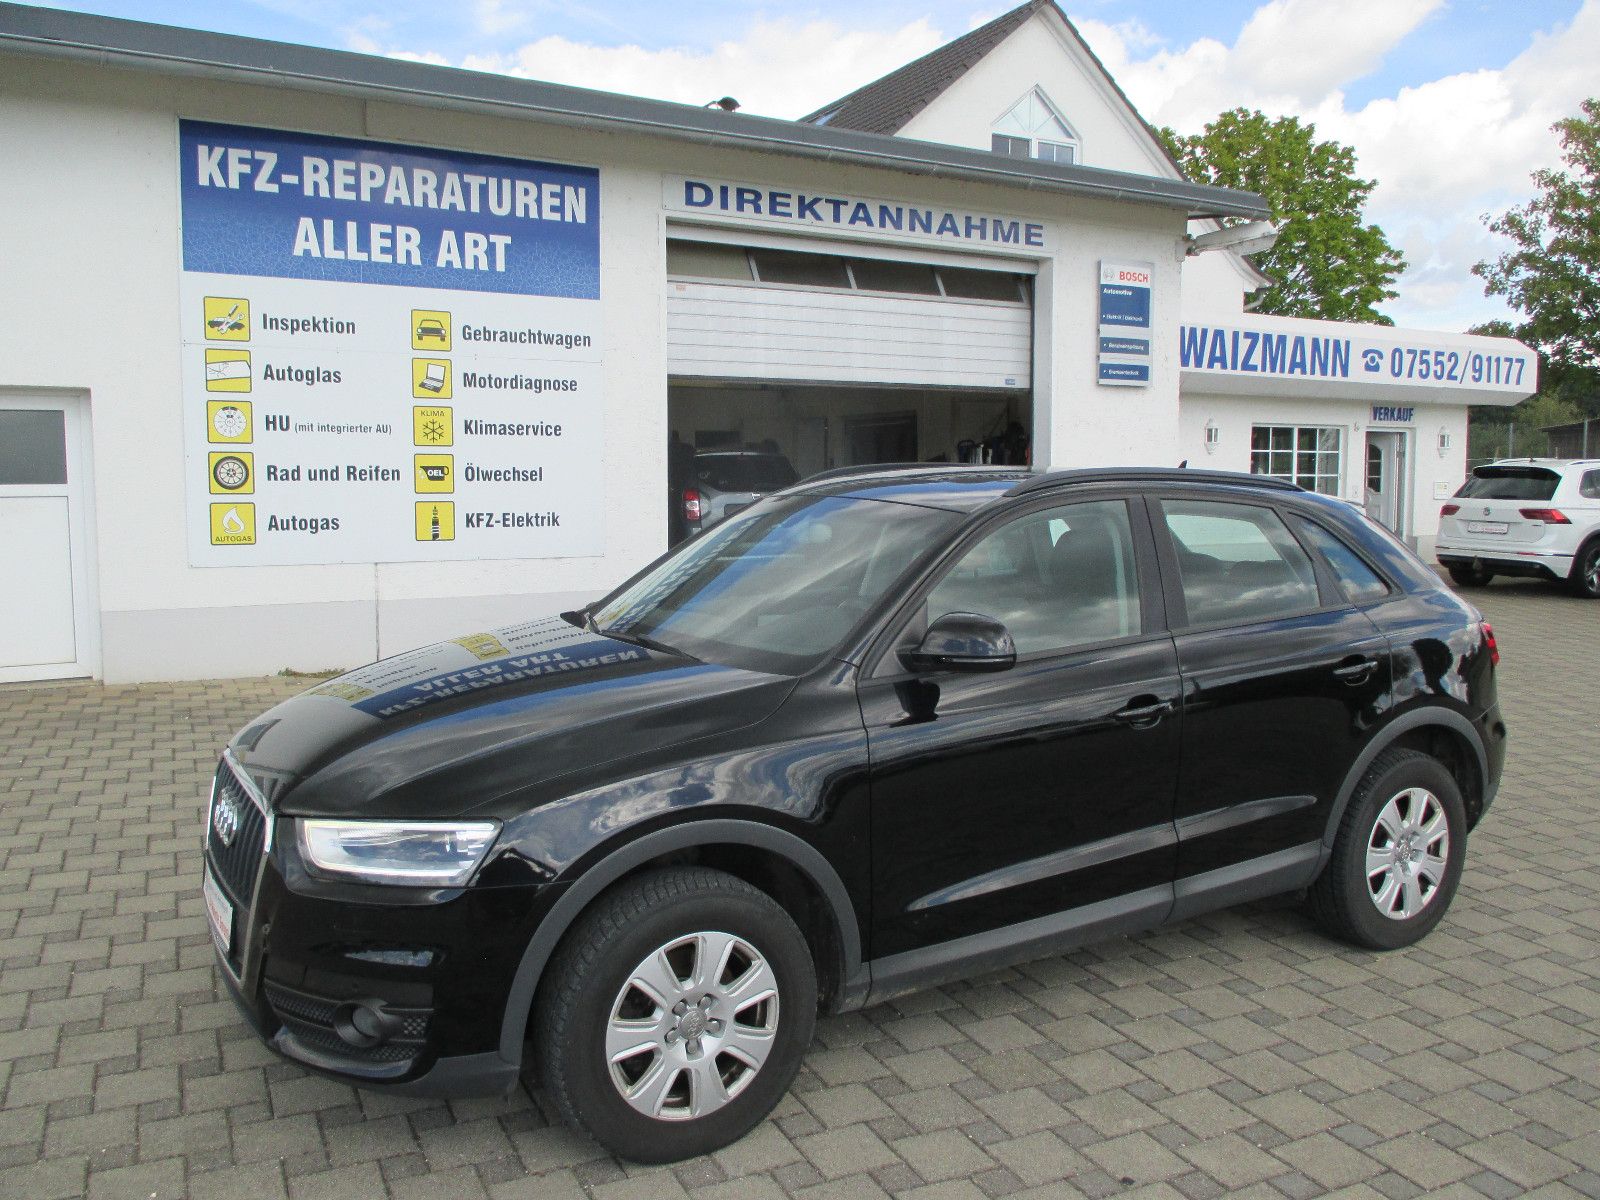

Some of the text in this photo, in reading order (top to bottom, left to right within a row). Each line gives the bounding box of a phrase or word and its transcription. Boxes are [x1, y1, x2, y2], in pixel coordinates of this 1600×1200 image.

[197, 144, 587, 224] KFZ-REPARATUREN
[685, 180, 1044, 247] DIREKTANNAHME
[293, 217, 512, 272] ALLER ART
[1119, 271, 1149, 283] BOSCH
[262, 313, 356, 335] Inspektion
[462, 325, 592, 349] Gebrauchtwagen
[1180, 326, 1526, 386] WAIZMANN 07552/91177
[263, 364, 342, 386] Autoglas
[463, 372, 578, 394] Motordiagnose
[265, 414, 392, 435] HU (mit integrierter AU)
[1372, 406, 1414, 422] VERKAUF
[464, 419, 562, 437] Klimaservice
[267, 464, 401, 482] Rad und Reifen
[427, 469, 444, 477] OEL
[465, 462, 543, 482] Ölwechsel
[268, 514, 340, 534] Autogas
[465, 511, 560, 529] KFZ-Elektrik
